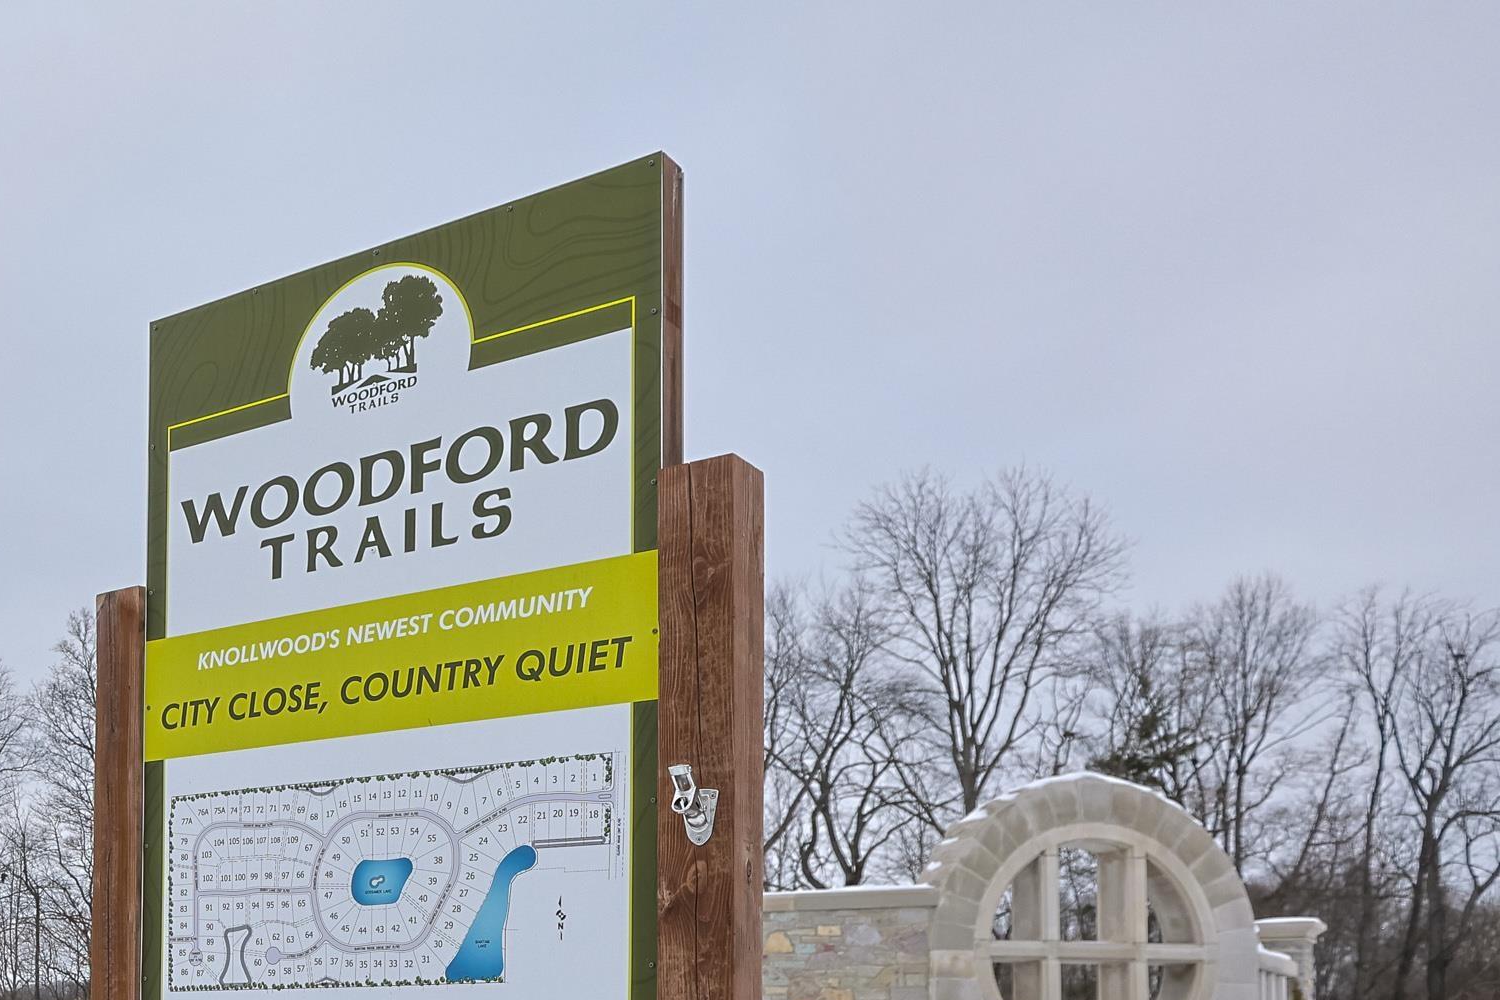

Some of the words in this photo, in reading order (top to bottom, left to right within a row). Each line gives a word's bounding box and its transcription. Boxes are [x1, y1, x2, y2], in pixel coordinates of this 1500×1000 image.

[332, 375, 418, 408] WOODFORD
[348, 392, 399, 414] TRAILS
[180, 398, 619, 543] WOODFORD
[260, 487, 512, 580] TRAILS
[197, 631, 340, 670] KNOLLWOOD'S
[347, 614, 432, 645] NEWEST
[438, 586, 594, 630] COMMUNITY
[160, 696, 220, 730] CITY
[228, 684, 328, 720] CLOSE,
[340, 655, 504, 705] COUNTRY
[514, 636, 633, 681] QUIET
[552, 776, 558, 784] 3
[571, 774, 576, 782] 2
[516, 780, 520, 788] 5
[384, 791, 391, 799] 13
[398, 789, 406, 798] 12
[414, 790, 422, 798] 11
[497, 788, 502, 796] 6
[354, 794, 362, 802] 15
[430, 794, 439, 802] 10
[482, 796, 487, 805] 7
[282, 804, 290, 812] 70
[339, 800, 347, 808] 16
[447, 801, 452, 810] 9
[326, 810, 334, 818] 17
[537, 811, 546, 820] 21
[553, 809, 563, 818] 20
[570, 808, 579, 817] 19
[589, 810, 598, 818] 18
[518, 816, 528, 824] 22
[376, 828, 384, 836] 52
[391, 827, 399, 835] 53
[410, 827, 419, 836] 54
[498, 824, 508, 832] 23
[360, 830, 368, 838] 51
[428, 834, 436, 842] 55
[242, 837, 253, 845] 106
[287, 836, 298, 844] 109
[434, 856, 443, 864] 38
[469, 853, 479, 861] 25
[282, 872, 290, 880] 97
[296, 870, 304, 878] 66
[466, 872, 475, 880] 26
[428, 877, 437, 885] 39
[459, 889, 468, 897] 27
[376, 925, 384, 933] 43
[391, 924, 400, 932] 42
[444, 921, 454, 929] 29
[434, 940, 443, 948] 30
[314, 957, 322, 966] 56
[330, 957, 338, 965] 37
[422, 955, 430, 964] 31
[345, 960, 354, 968] 36
[360, 960, 368, 969] 35
[389, 960, 398, 968] 33
[404, 960, 413, 968] 32
